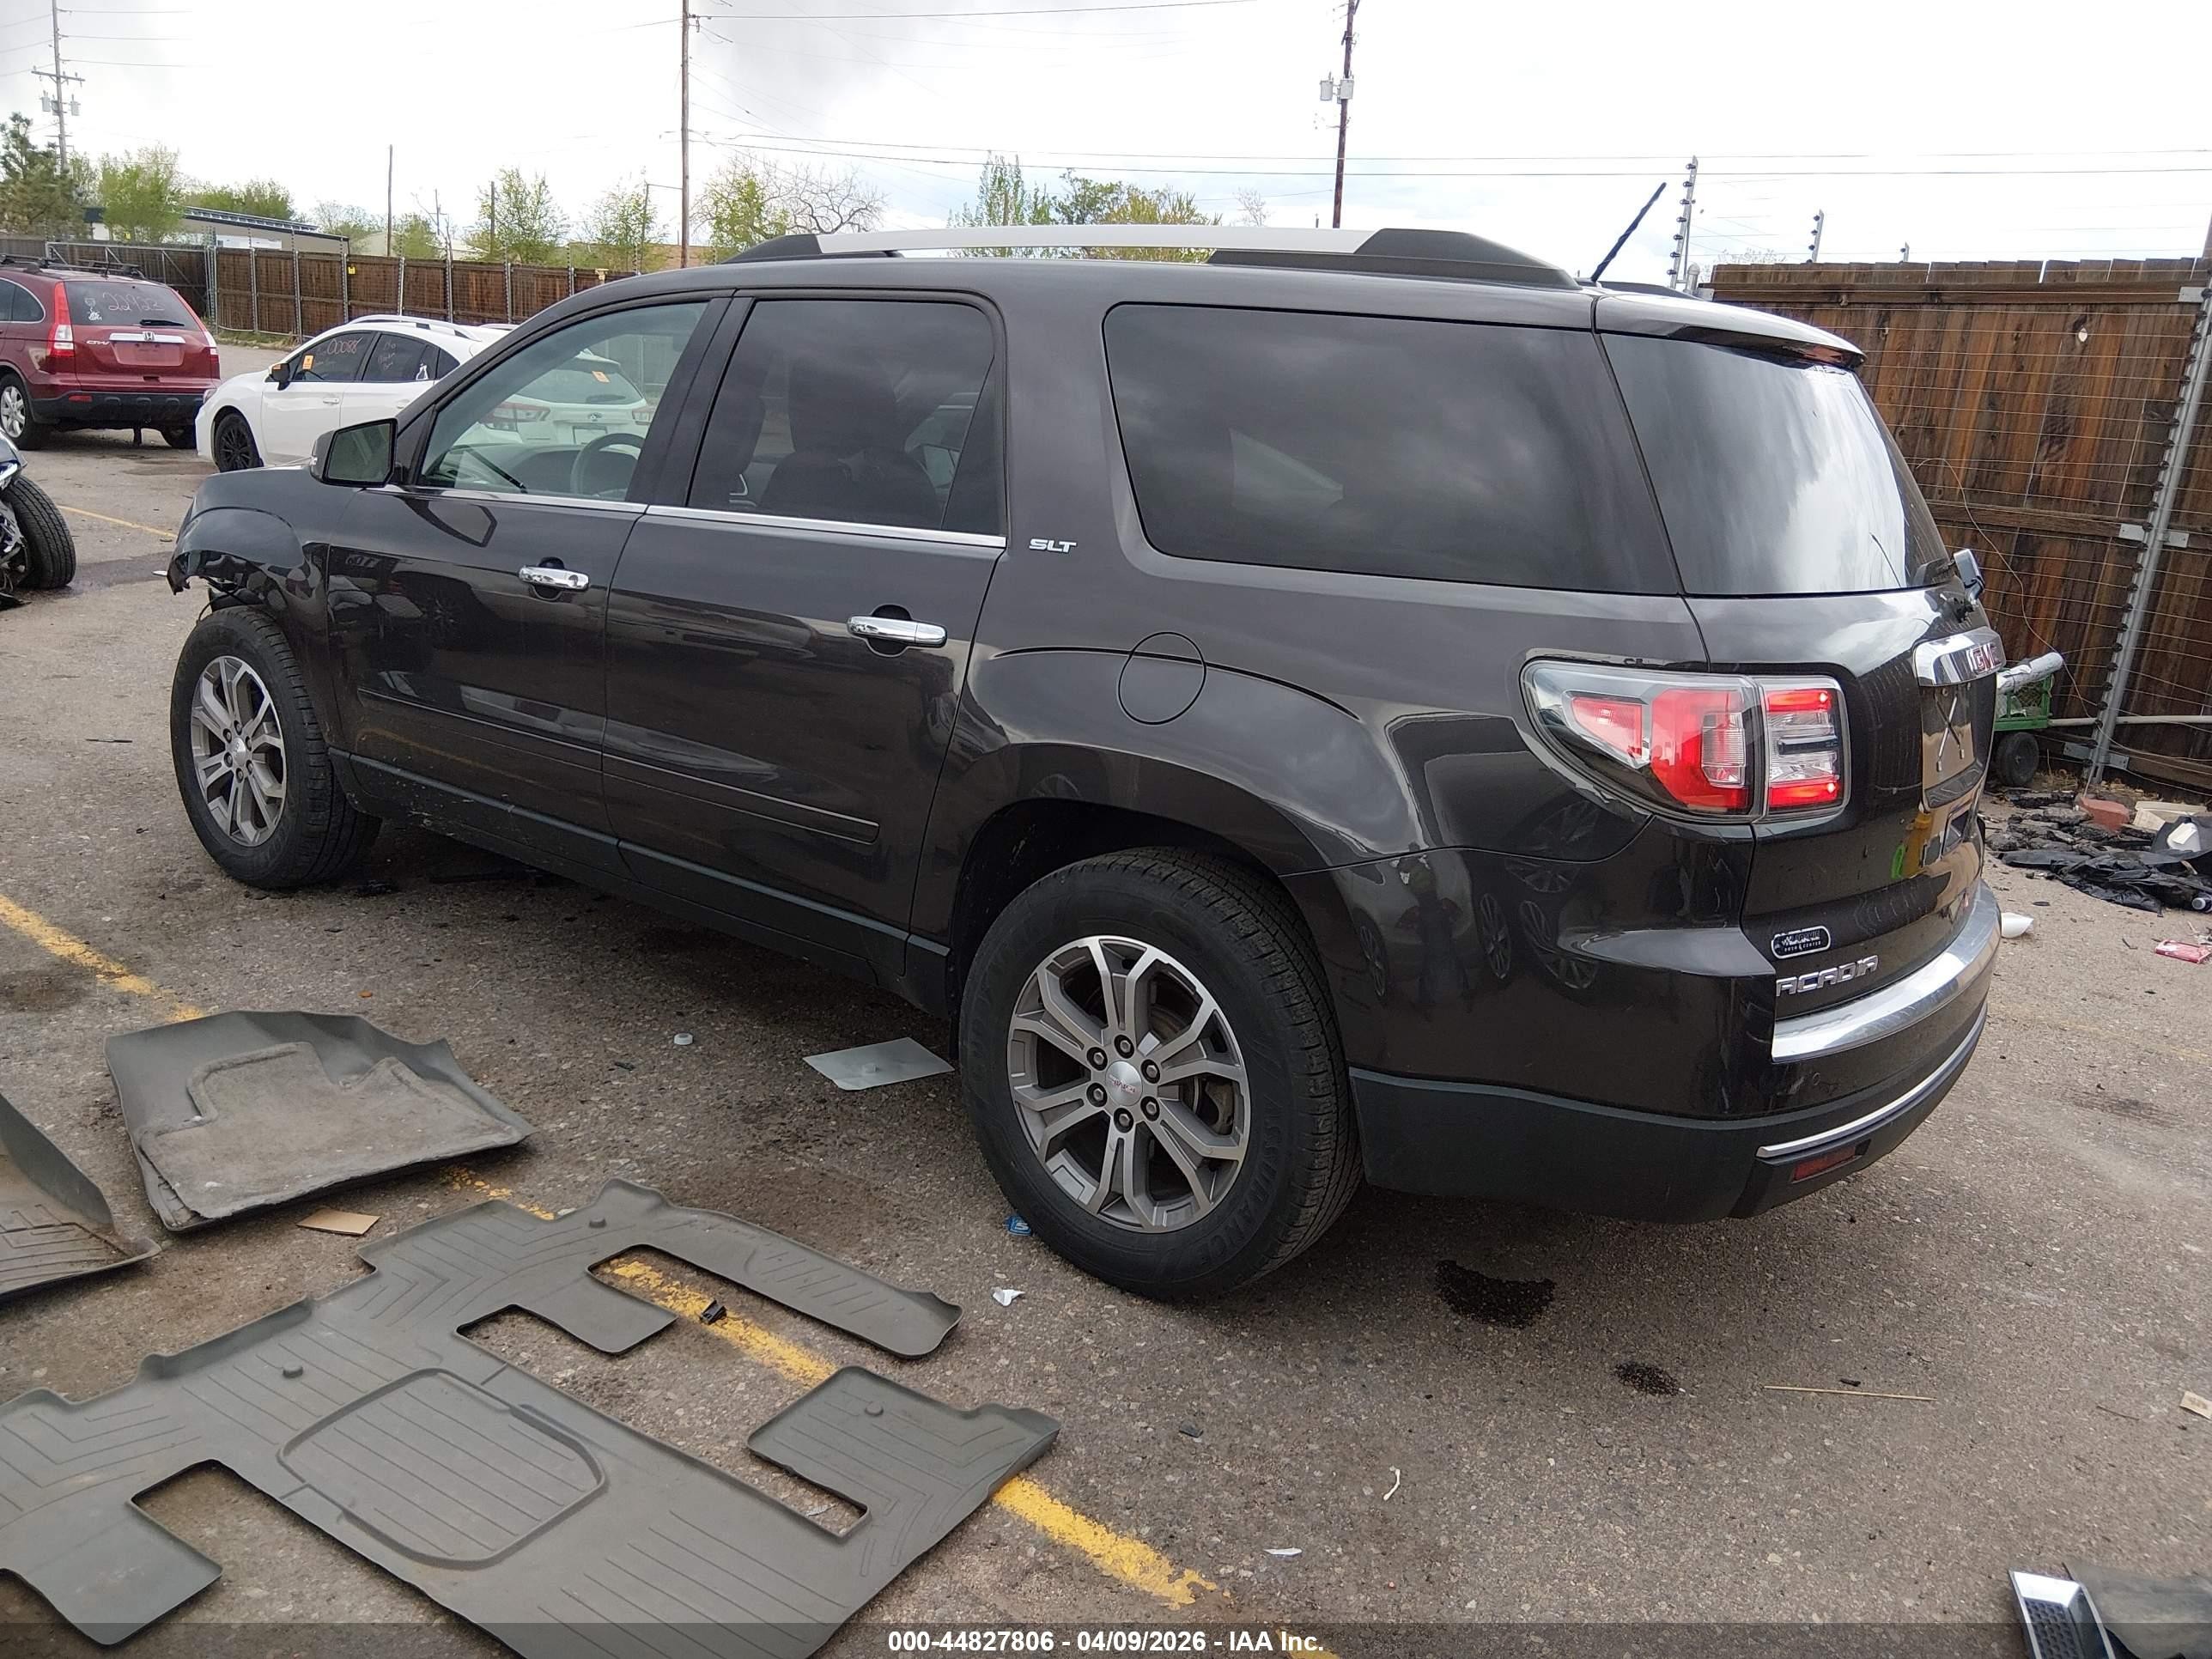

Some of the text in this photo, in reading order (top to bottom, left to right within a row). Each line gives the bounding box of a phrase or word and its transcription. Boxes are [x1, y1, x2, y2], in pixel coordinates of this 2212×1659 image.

[1029, 538, 1078, 554] SLT
[1972, 643, 2002, 674] GMC
[1776, 955, 1879, 996] ACADIA
